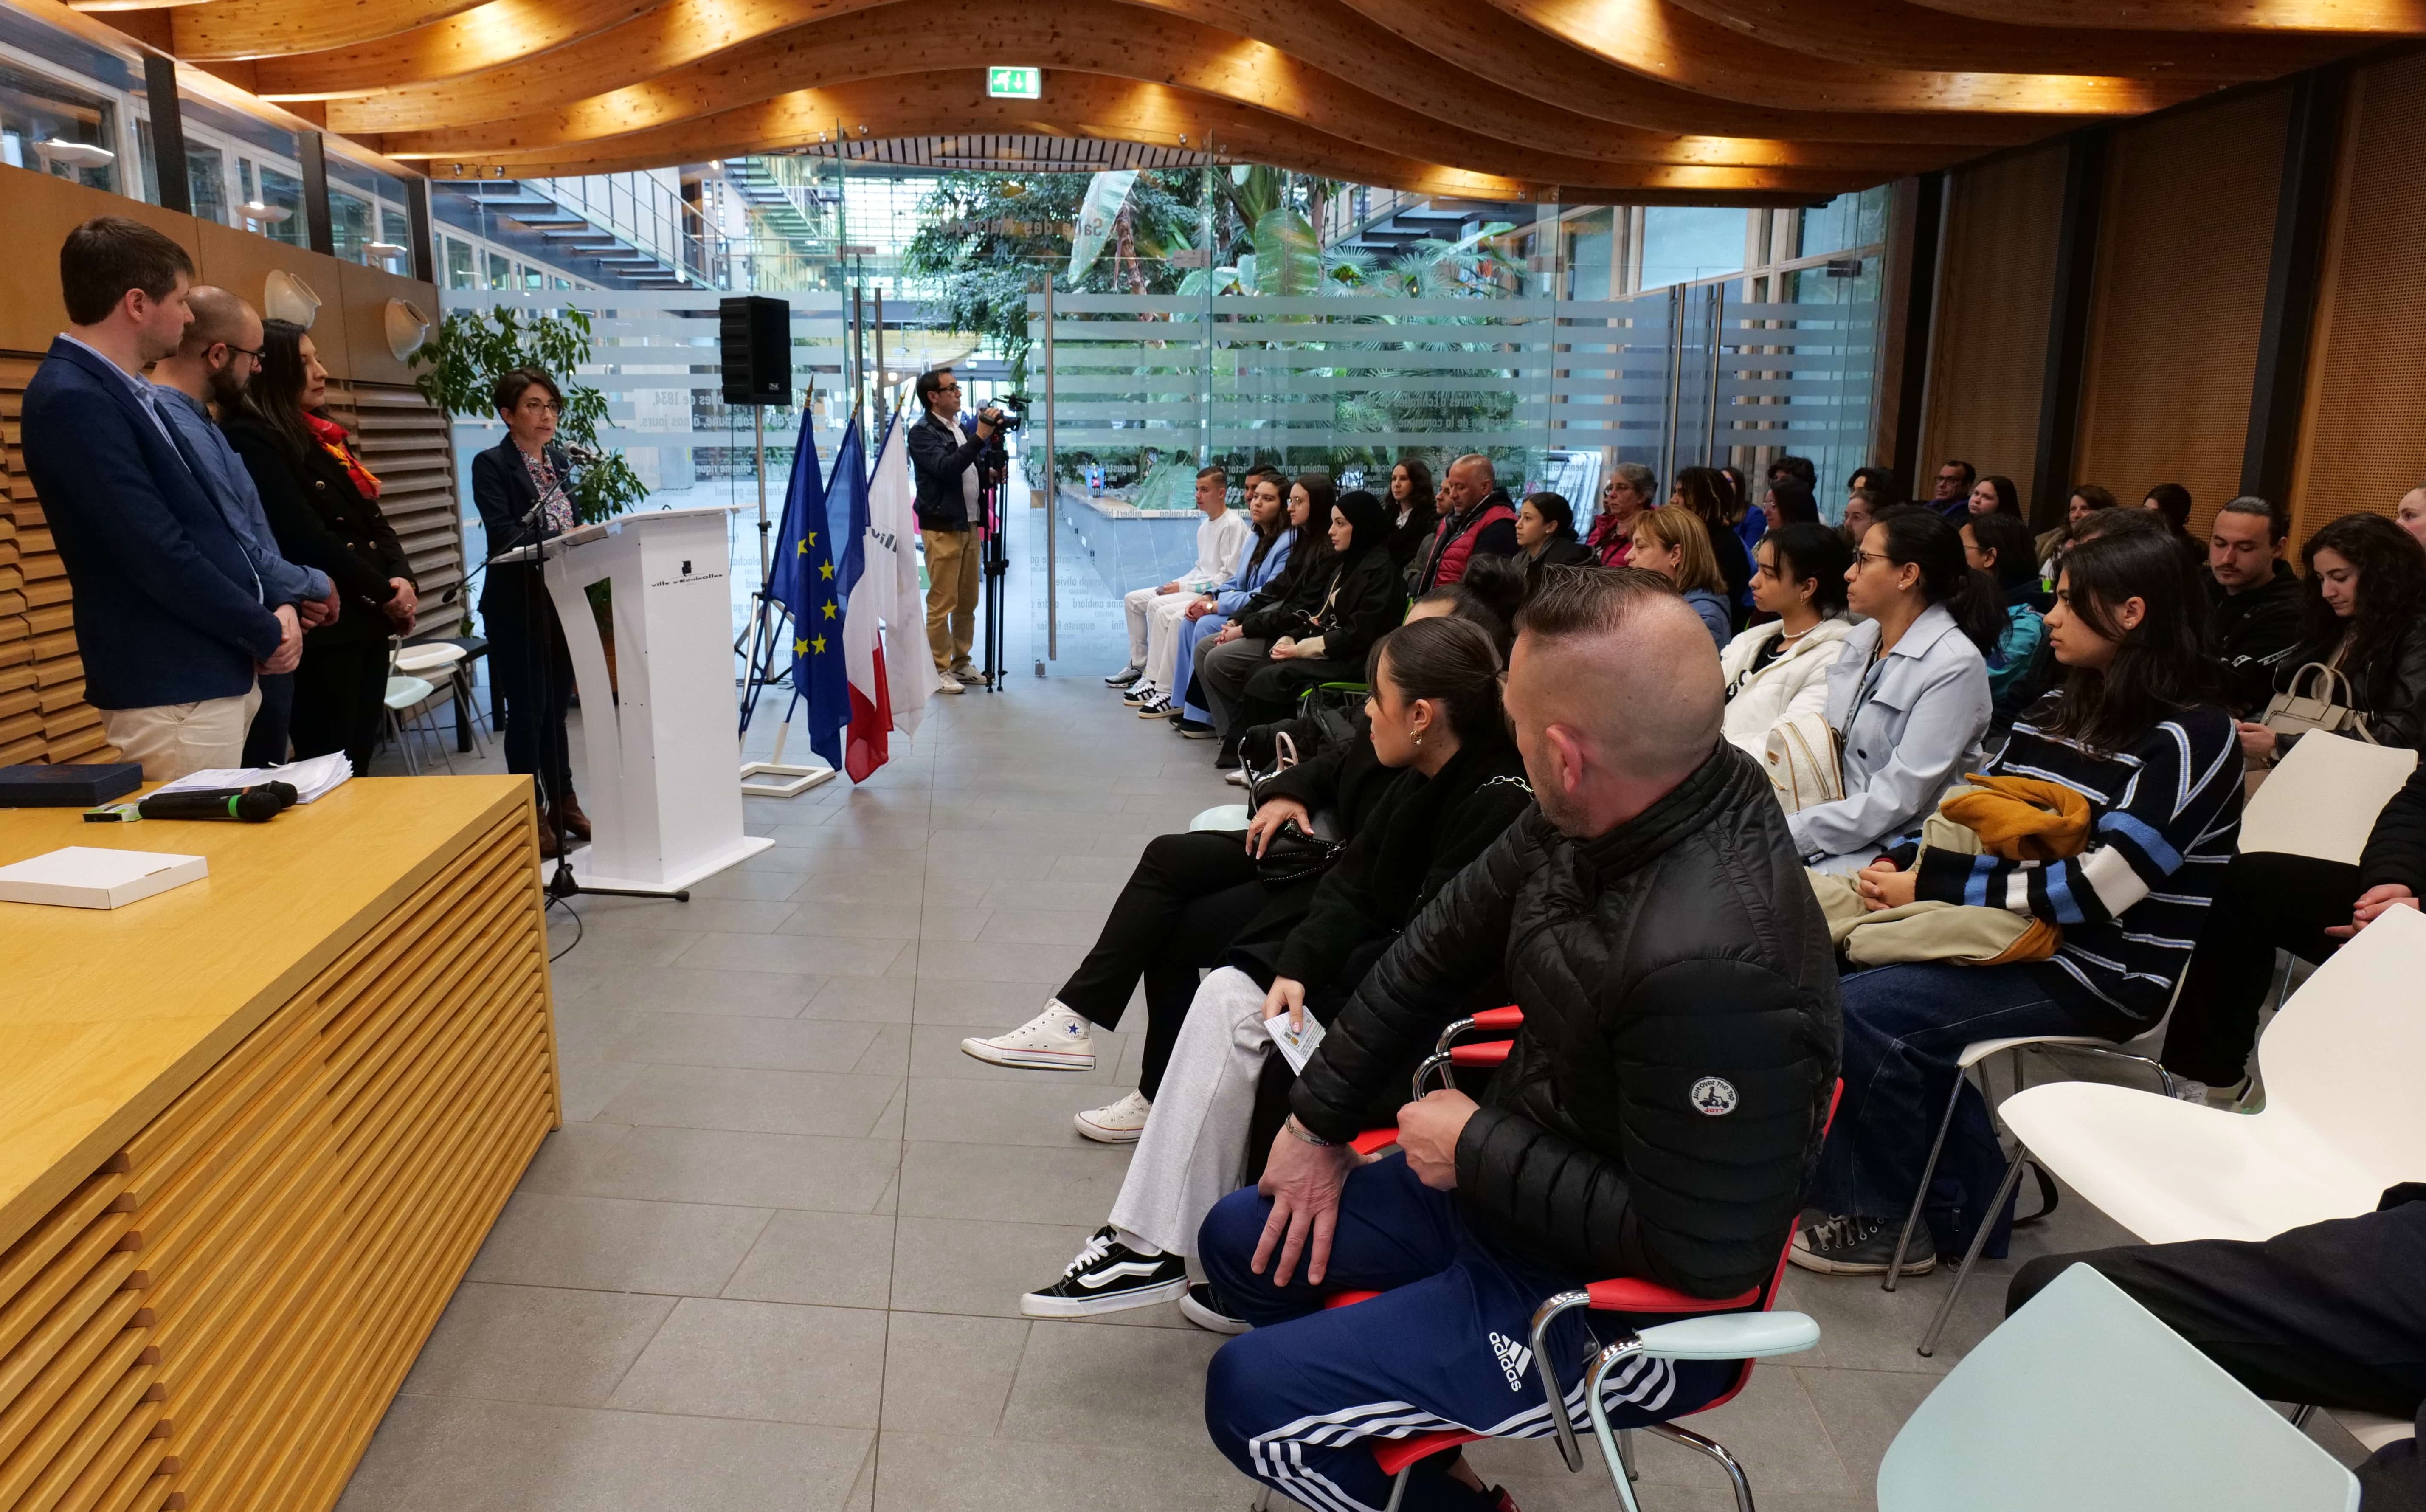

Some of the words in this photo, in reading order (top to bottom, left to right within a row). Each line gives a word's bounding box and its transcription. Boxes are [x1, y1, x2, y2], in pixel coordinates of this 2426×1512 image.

[1699, 1080, 1716, 1088] Over
[1716, 1081, 1729, 1091] The
[1489, 1332, 1522, 1392] adidas
